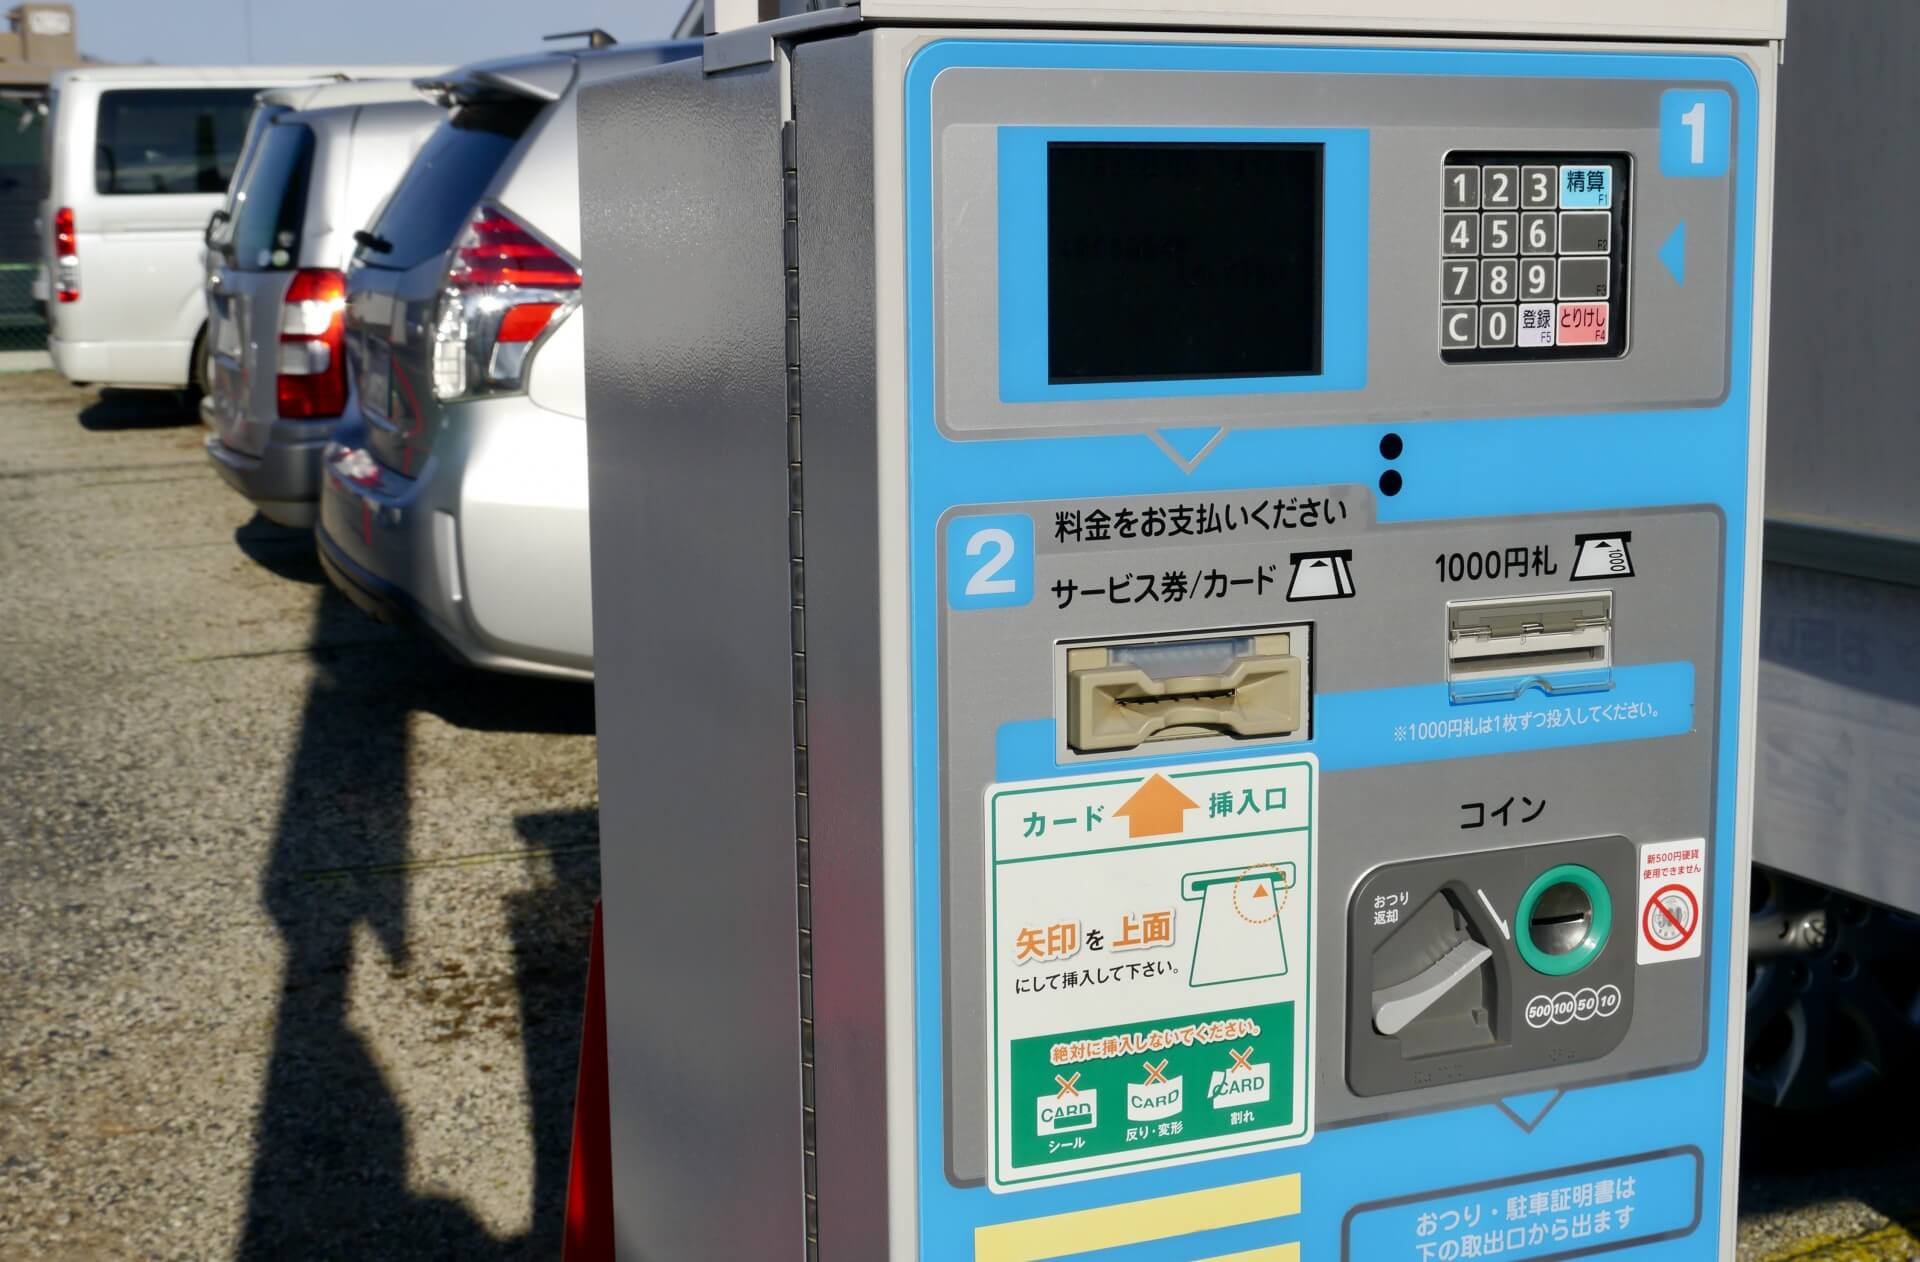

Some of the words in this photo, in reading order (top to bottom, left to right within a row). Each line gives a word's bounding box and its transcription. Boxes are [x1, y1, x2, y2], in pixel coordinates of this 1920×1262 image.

[1682, 103, 1705, 164] 1
[1453, 173, 1466, 202] 1
[1491, 173, 1508, 202] 2
[1531, 173, 1547, 202] 3
[1566, 170, 1605, 193] 精算
[1598, 194, 1608, 206] F1
[1450, 220, 1469, 249] 4
[1492, 220, 1508, 248] 5
[1529, 219, 1546, 248] 6
[1597, 239, 1608, 250] F2
[1451, 267, 1469, 295] 7
[1490, 266, 1507, 295] 8
[1528, 265, 1545, 294] 9
[1449, 313, 1468, 341] C
[1489, 312, 1507, 341] 0
[1522, 309, 1551, 329] 登録
[1560, 307, 1605, 328] とりけし
[1540, 331, 1552, 343] F5
[1595, 329, 1606, 341] F4
[1054, 497, 1347, 543] 料金をお支払いください
[965, 528, 1017, 596] 2
[1435, 545, 1558, 583] 1000円札
[1608, 548, 1626, 572] 1000
[1050, 564, 1277, 609] サービス券/カード
[1022, 804, 1104, 838] カード
[1208, 787, 1288, 819] 挿入口
[1460, 796, 1546, 829] コイン
[1643, 864, 1702, 880] 使用できません
[1373, 890, 1410, 907] おつり
[1373, 909, 1400, 925] 返却
[1529, 1004, 1550, 1017] 500
[1554, 1001, 1574, 1014] 100
[1578, 998, 1594, 1010] 50
[1601, 995, 1616, 1006] 10
[1131, 1089, 1180, 1110] CARD
[1230, 1110, 1255, 1125] 割れ
[1126, 1121, 1184, 1142] 反り・変形
[1048, 1137, 1086, 1153] シール
[1415, 1175, 1637, 1237] おつり・駐車証明書は
[1415, 1204, 1635, 1262] 下の取出口から出ます
